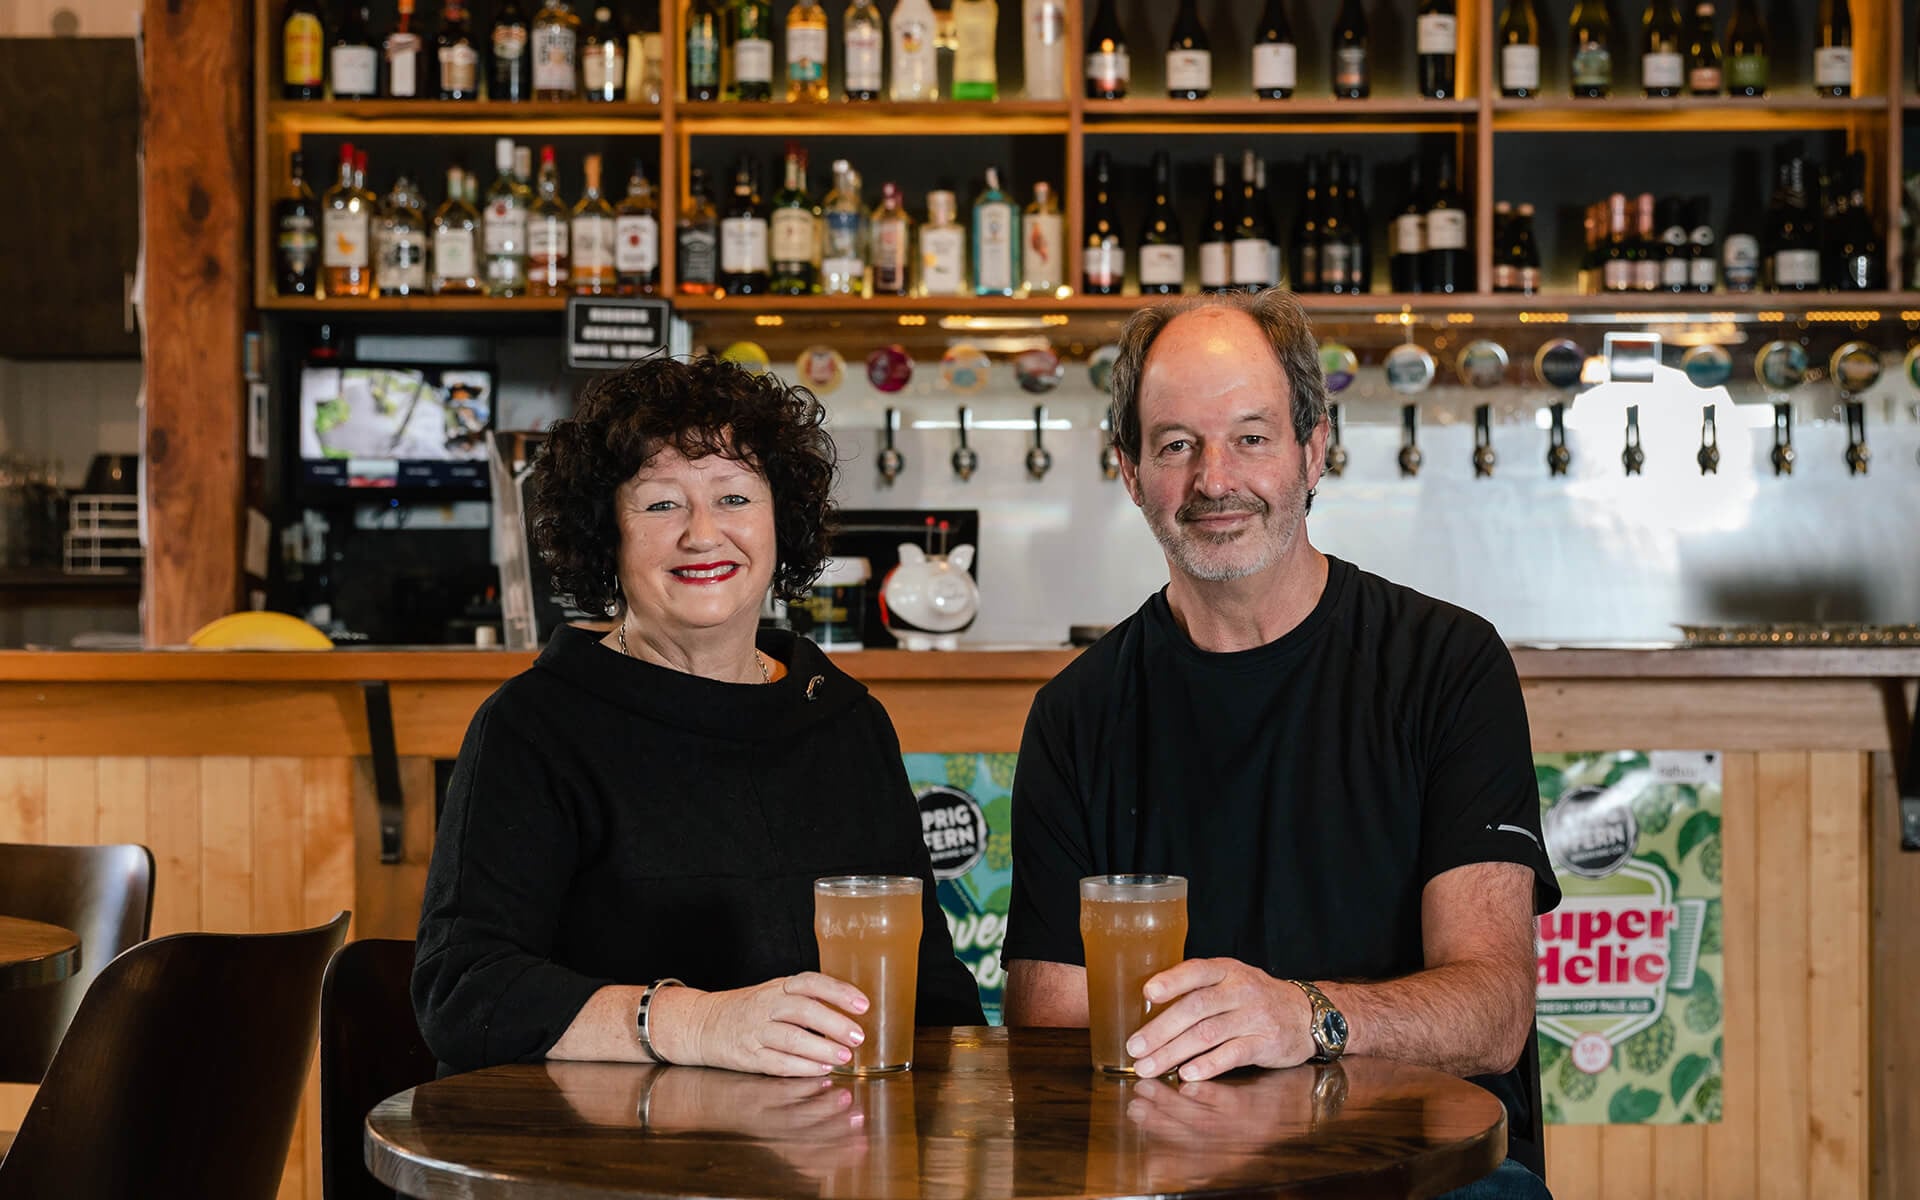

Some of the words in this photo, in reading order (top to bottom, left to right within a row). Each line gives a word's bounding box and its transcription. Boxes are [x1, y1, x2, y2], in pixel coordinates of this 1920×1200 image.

[921, 804, 971, 832] PRIG
[923, 825, 976, 851] FERN
[1540, 910, 1674, 949] uper
[1537, 944, 1665, 984] delic
